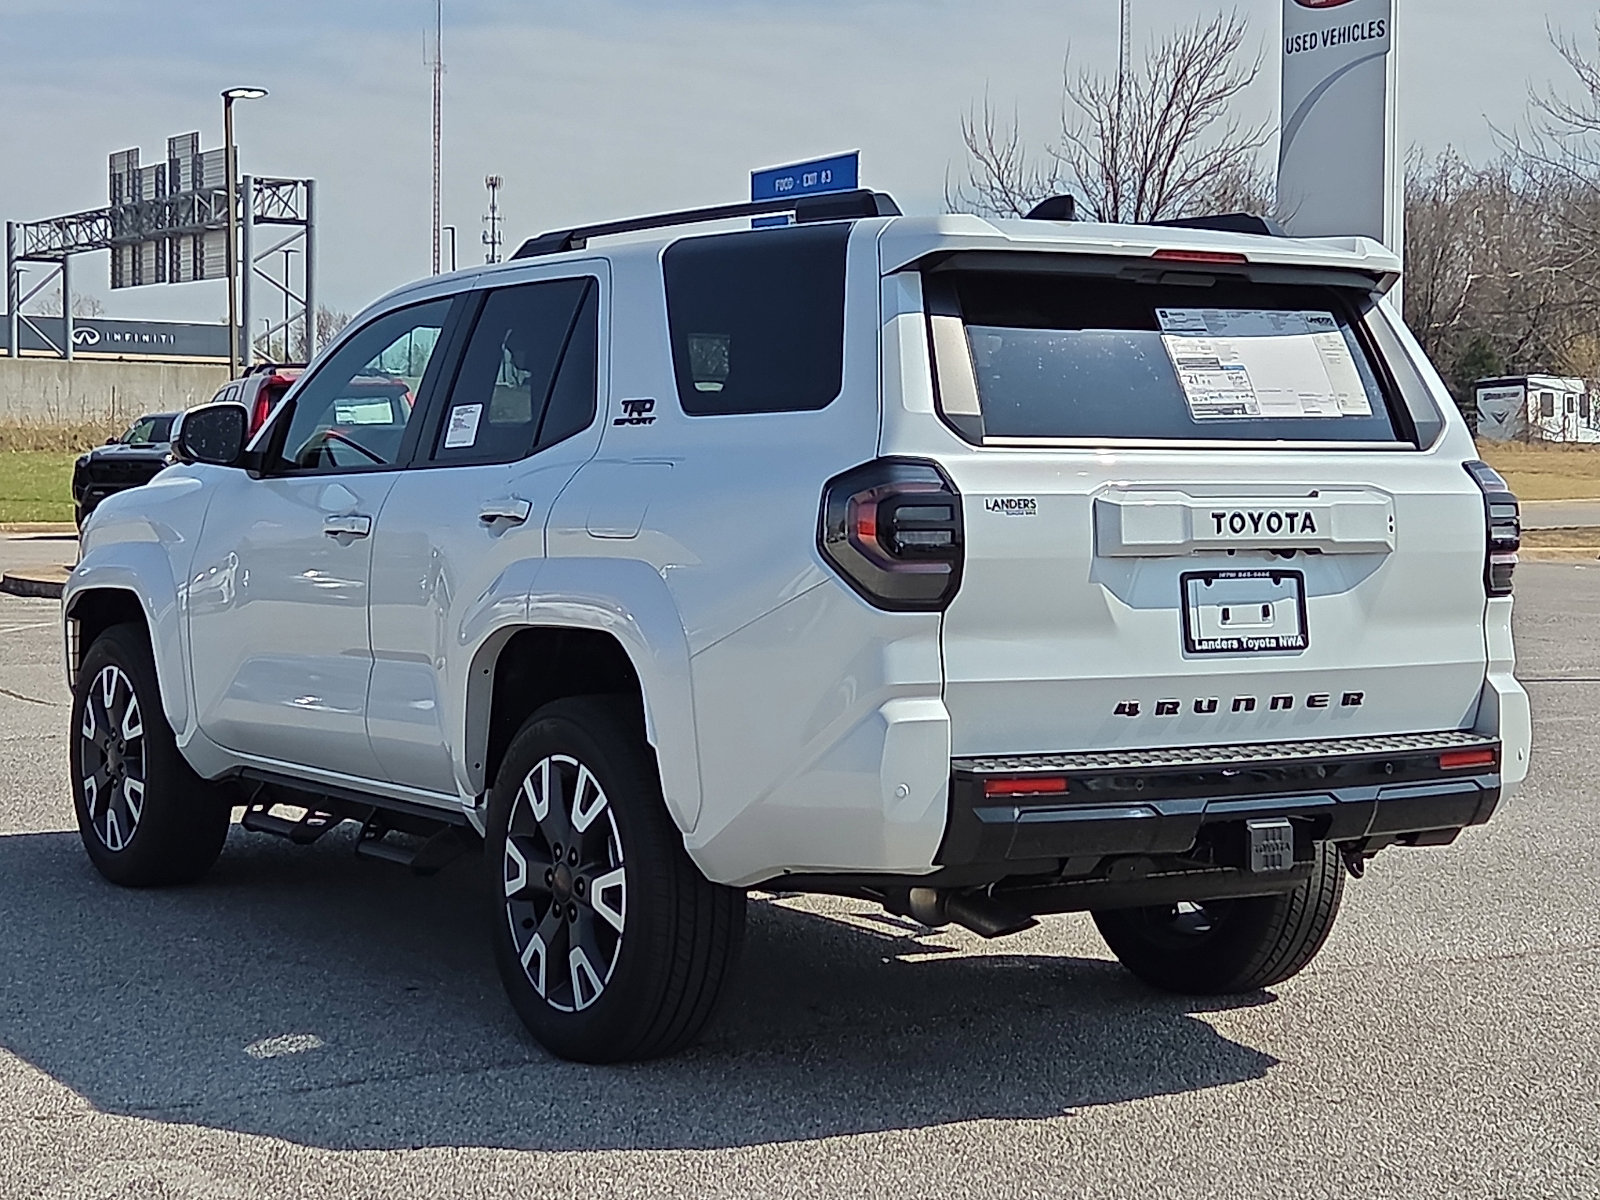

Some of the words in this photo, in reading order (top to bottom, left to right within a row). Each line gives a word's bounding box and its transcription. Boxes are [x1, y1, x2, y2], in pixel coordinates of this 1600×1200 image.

[1286, 32, 1318, 54] USED
[1321, 19, 1386, 47] VEHICLES
[775, 177, 794, 192] FOOD
[106, 332, 175, 345] INFINITI
[621, 399, 656, 417] TRD
[985, 498, 1037, 511] LANDERS
[1211, 511, 1317, 535] TOYOTA
[1195, 638, 1239, 650] Landers
[1241, 636, 1277, 650] Toyota
[1279, 635, 1305, 647] NWA
[1113, 691, 1365, 717] 4RUNNER
